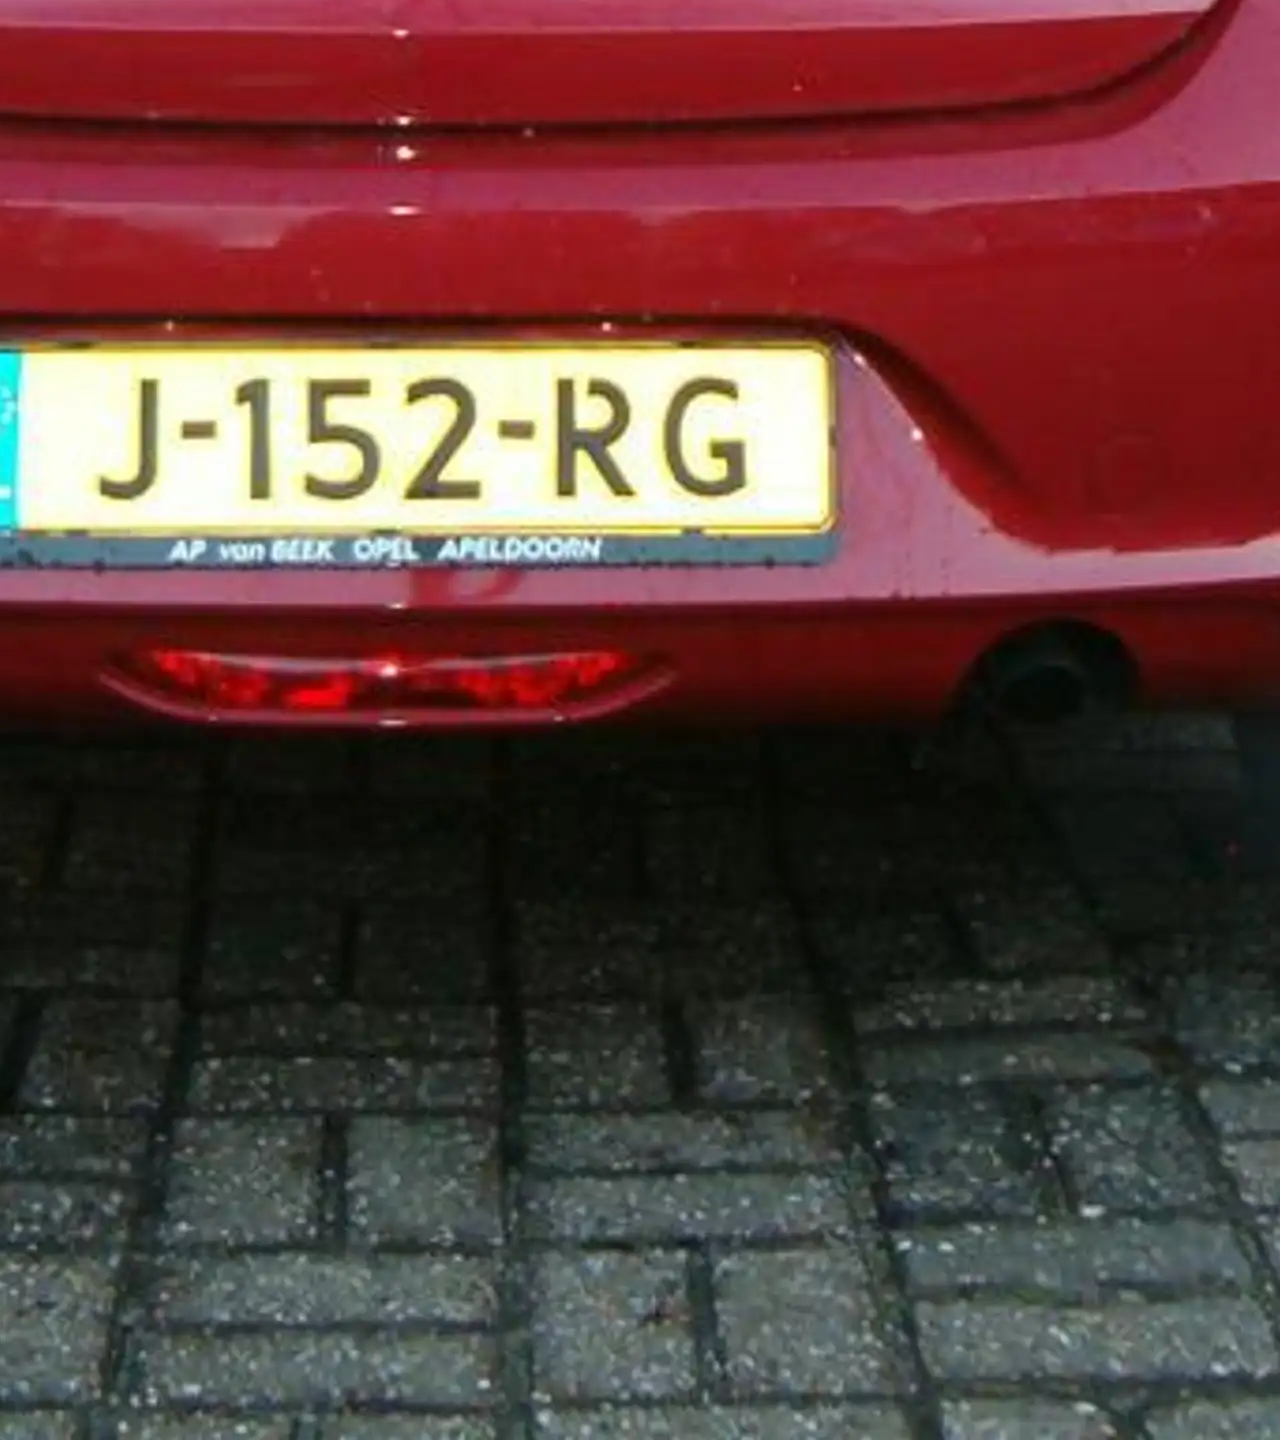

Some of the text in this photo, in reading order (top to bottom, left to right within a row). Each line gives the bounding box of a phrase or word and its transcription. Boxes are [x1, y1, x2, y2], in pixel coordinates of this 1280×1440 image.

[99, 377, 747, 500] J-152-RG
[169, 536, 603, 562] AP van BEEK OPEL APELDOORN
